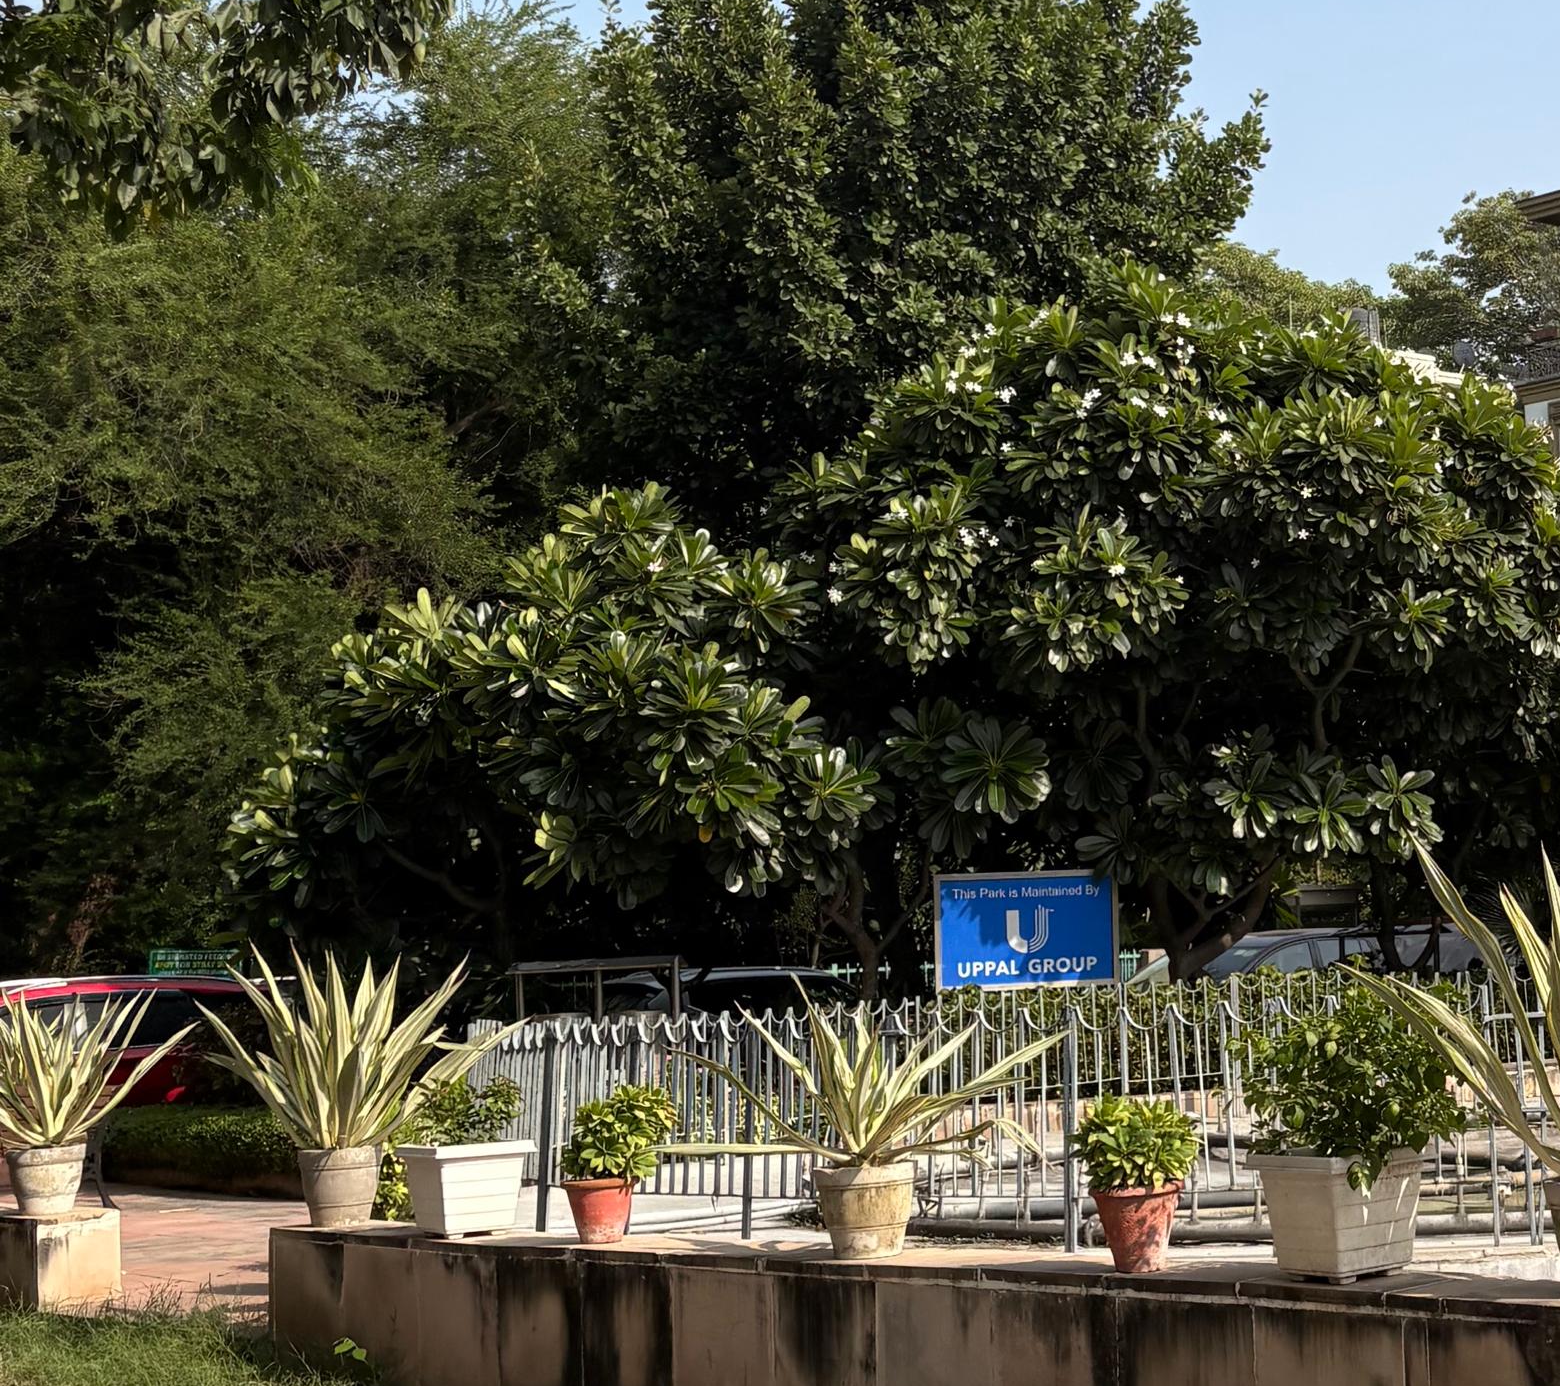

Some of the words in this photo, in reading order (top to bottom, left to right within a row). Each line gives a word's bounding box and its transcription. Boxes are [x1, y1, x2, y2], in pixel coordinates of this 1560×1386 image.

[952, 888, 976, 900] This
[979, 887, 1006, 899] Park
[1008, 886, 1018, 898] is
[1021, 884, 1082, 898] Maintained
[1085, 884, 1100, 898] By
[957, 959, 1020, 978] UPPAL
[1027, 956, 1098, 974] GROUP
